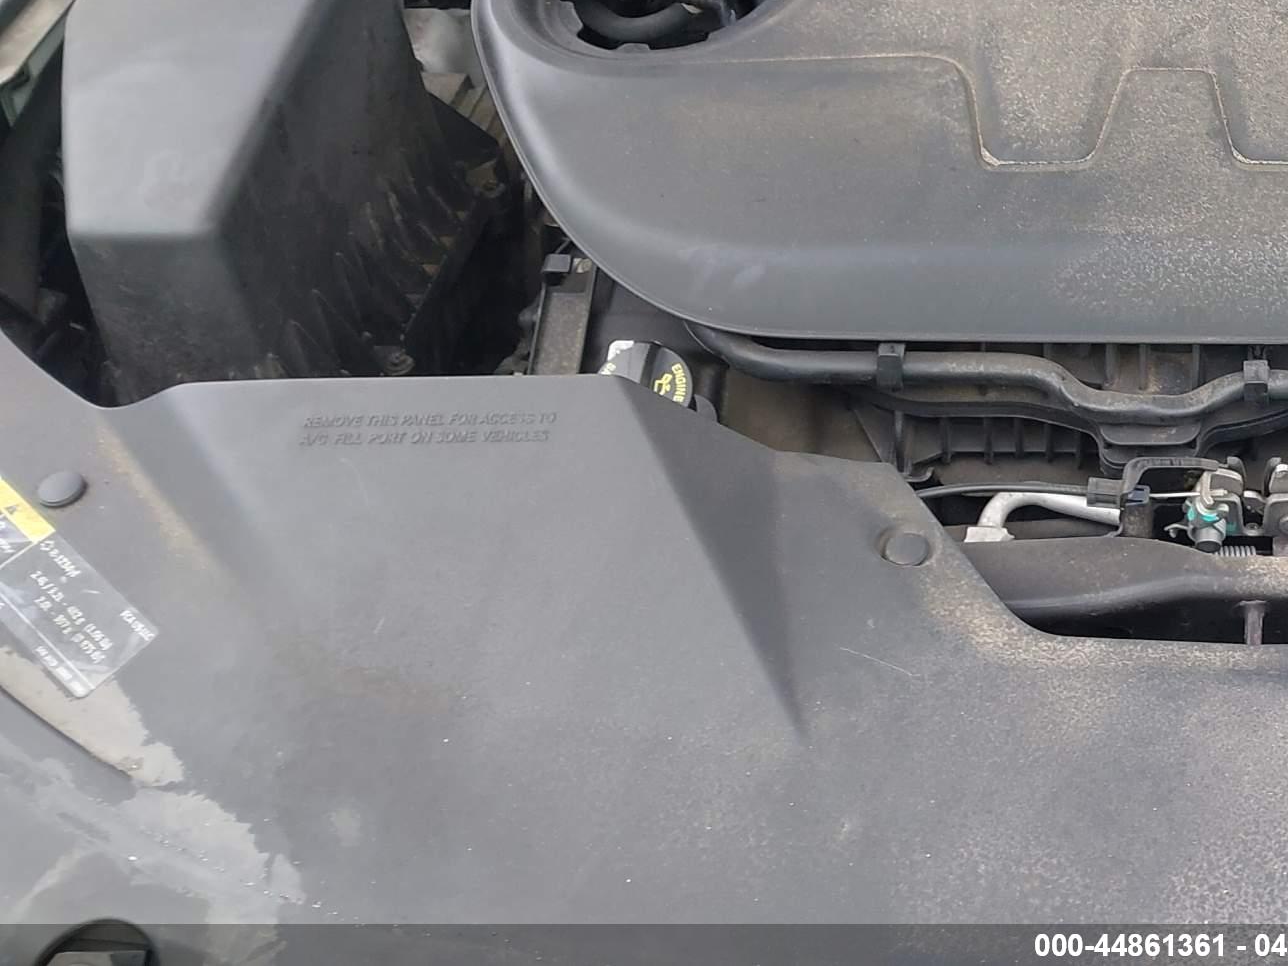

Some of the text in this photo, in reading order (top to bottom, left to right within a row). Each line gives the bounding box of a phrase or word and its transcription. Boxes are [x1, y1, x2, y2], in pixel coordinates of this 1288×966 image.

[302, 412, 559, 429] REMOVE THIS PANEL FOR ACCESS TO
[298, 429, 550, 446] A/C FILL PORT ON SOME VEHICLES
